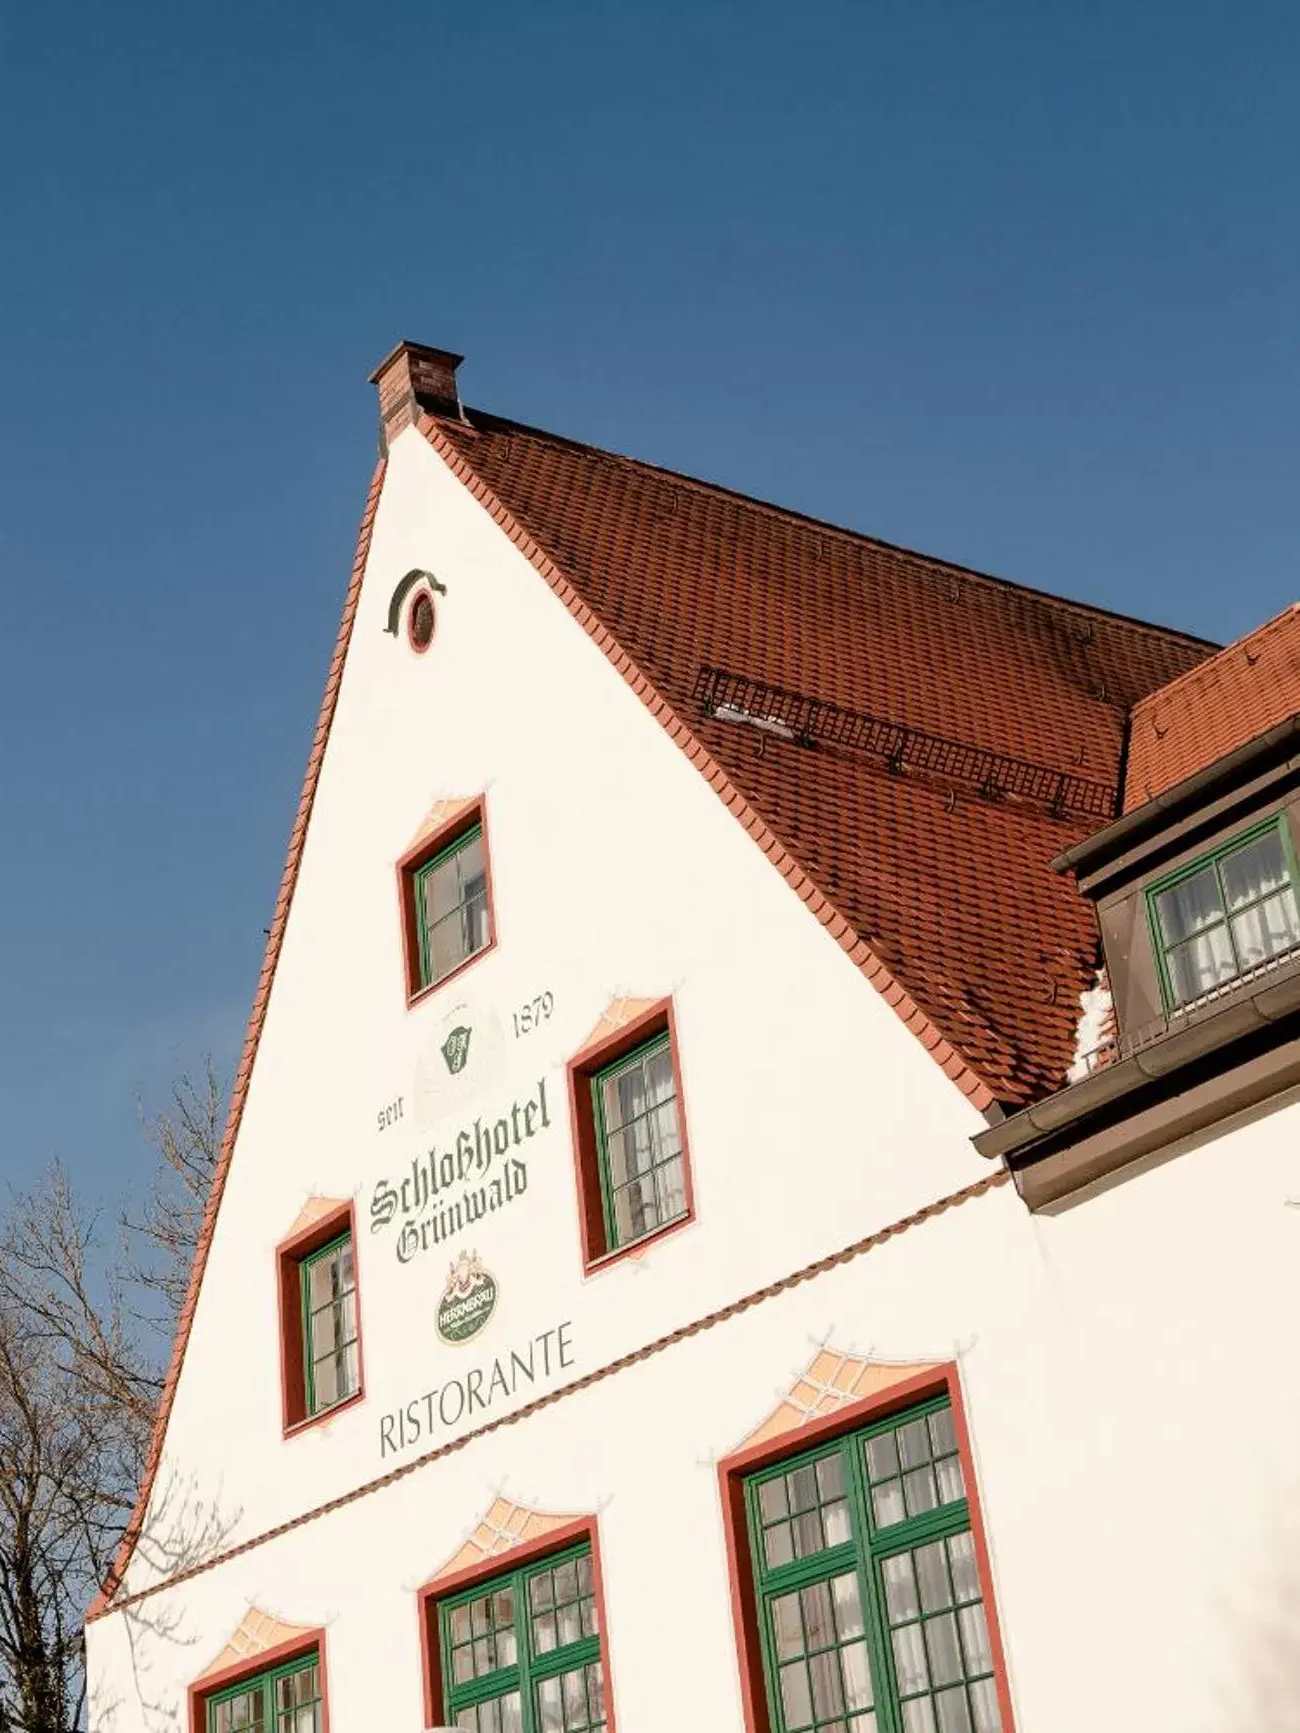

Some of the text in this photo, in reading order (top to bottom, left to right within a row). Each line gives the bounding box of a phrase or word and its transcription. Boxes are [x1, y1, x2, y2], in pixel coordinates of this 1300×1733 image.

[370, 1077, 551, 1234] Schloßhotel
[396, 1157, 527, 1264] Grünwald
[380, 1321, 575, 1458] RISTORANTE
